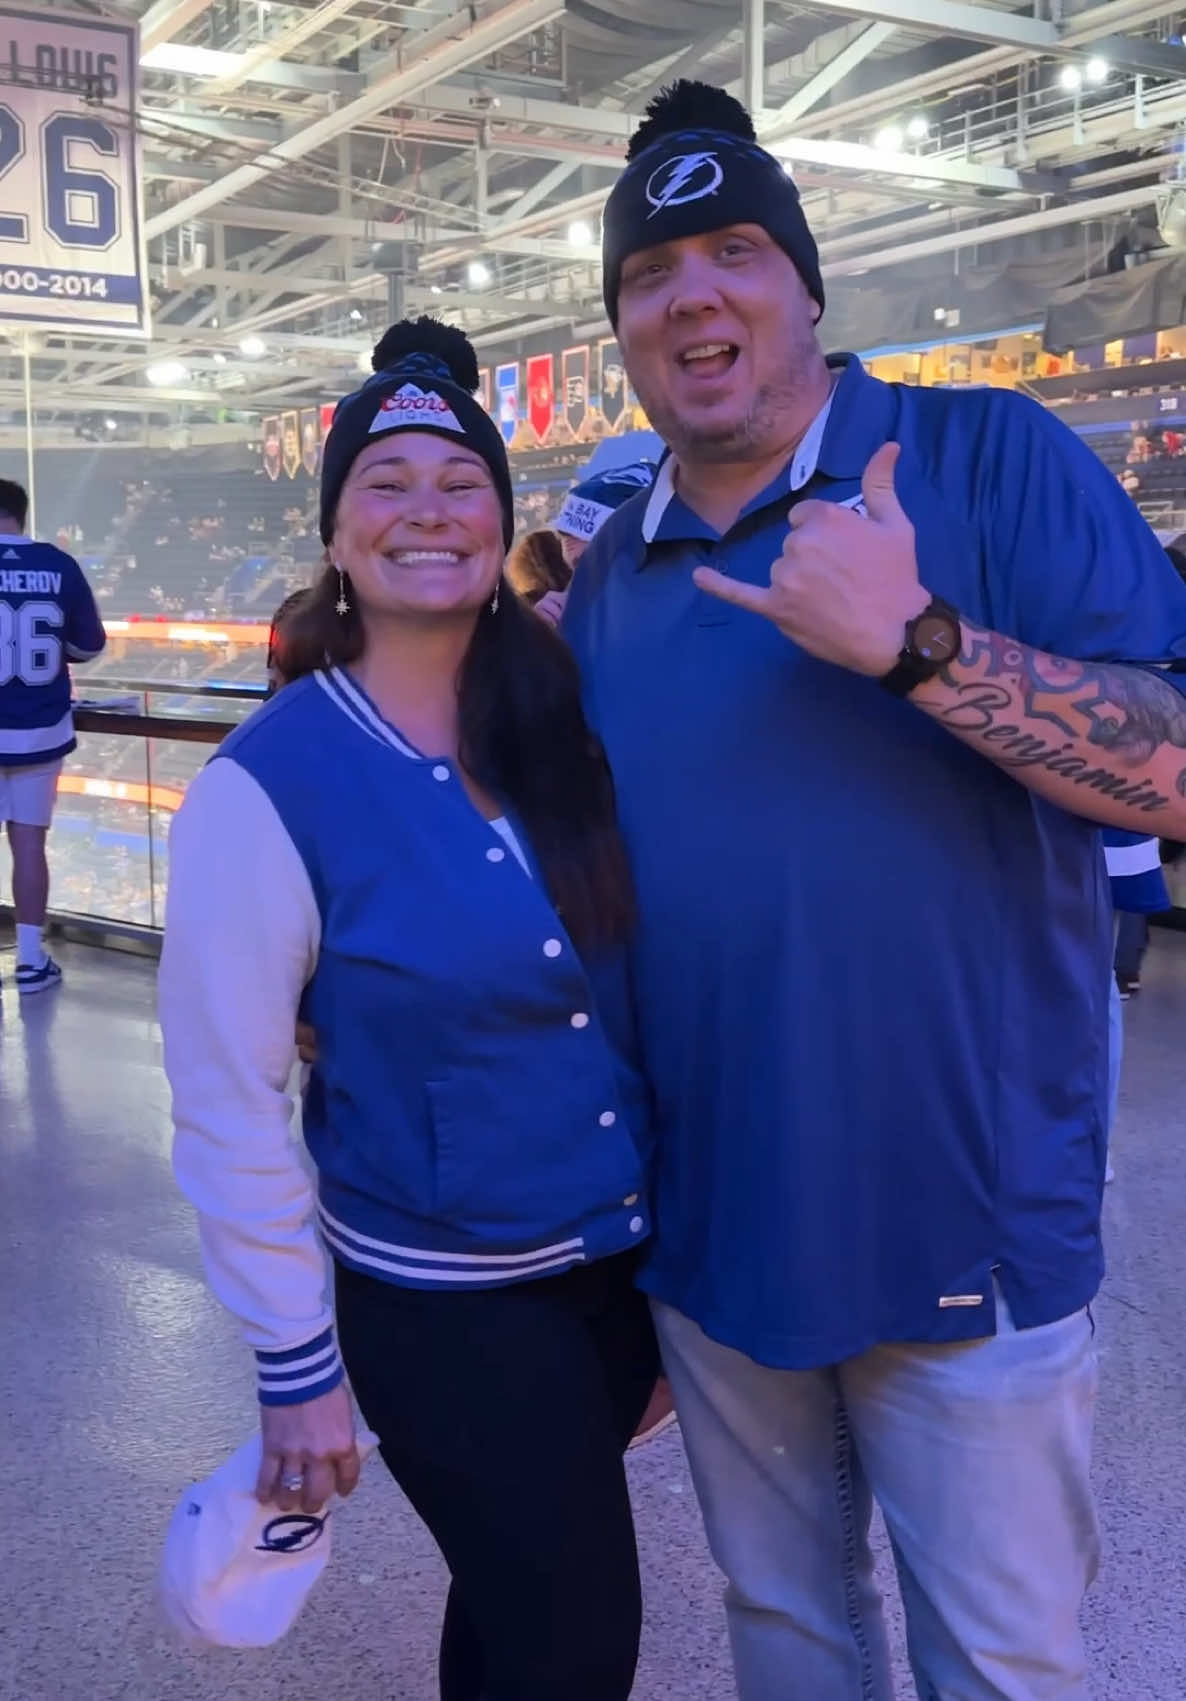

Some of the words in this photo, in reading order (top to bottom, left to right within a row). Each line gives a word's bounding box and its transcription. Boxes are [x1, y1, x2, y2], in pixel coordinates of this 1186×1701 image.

[9, 40, 118, 99] LOUIS
[0, 268, 108, 298] 00-2014
[381, 393, 453, 412] Coors
[0, 568, 62, 594] HEROV
[916, 682, 1169, 813] Benjamin
